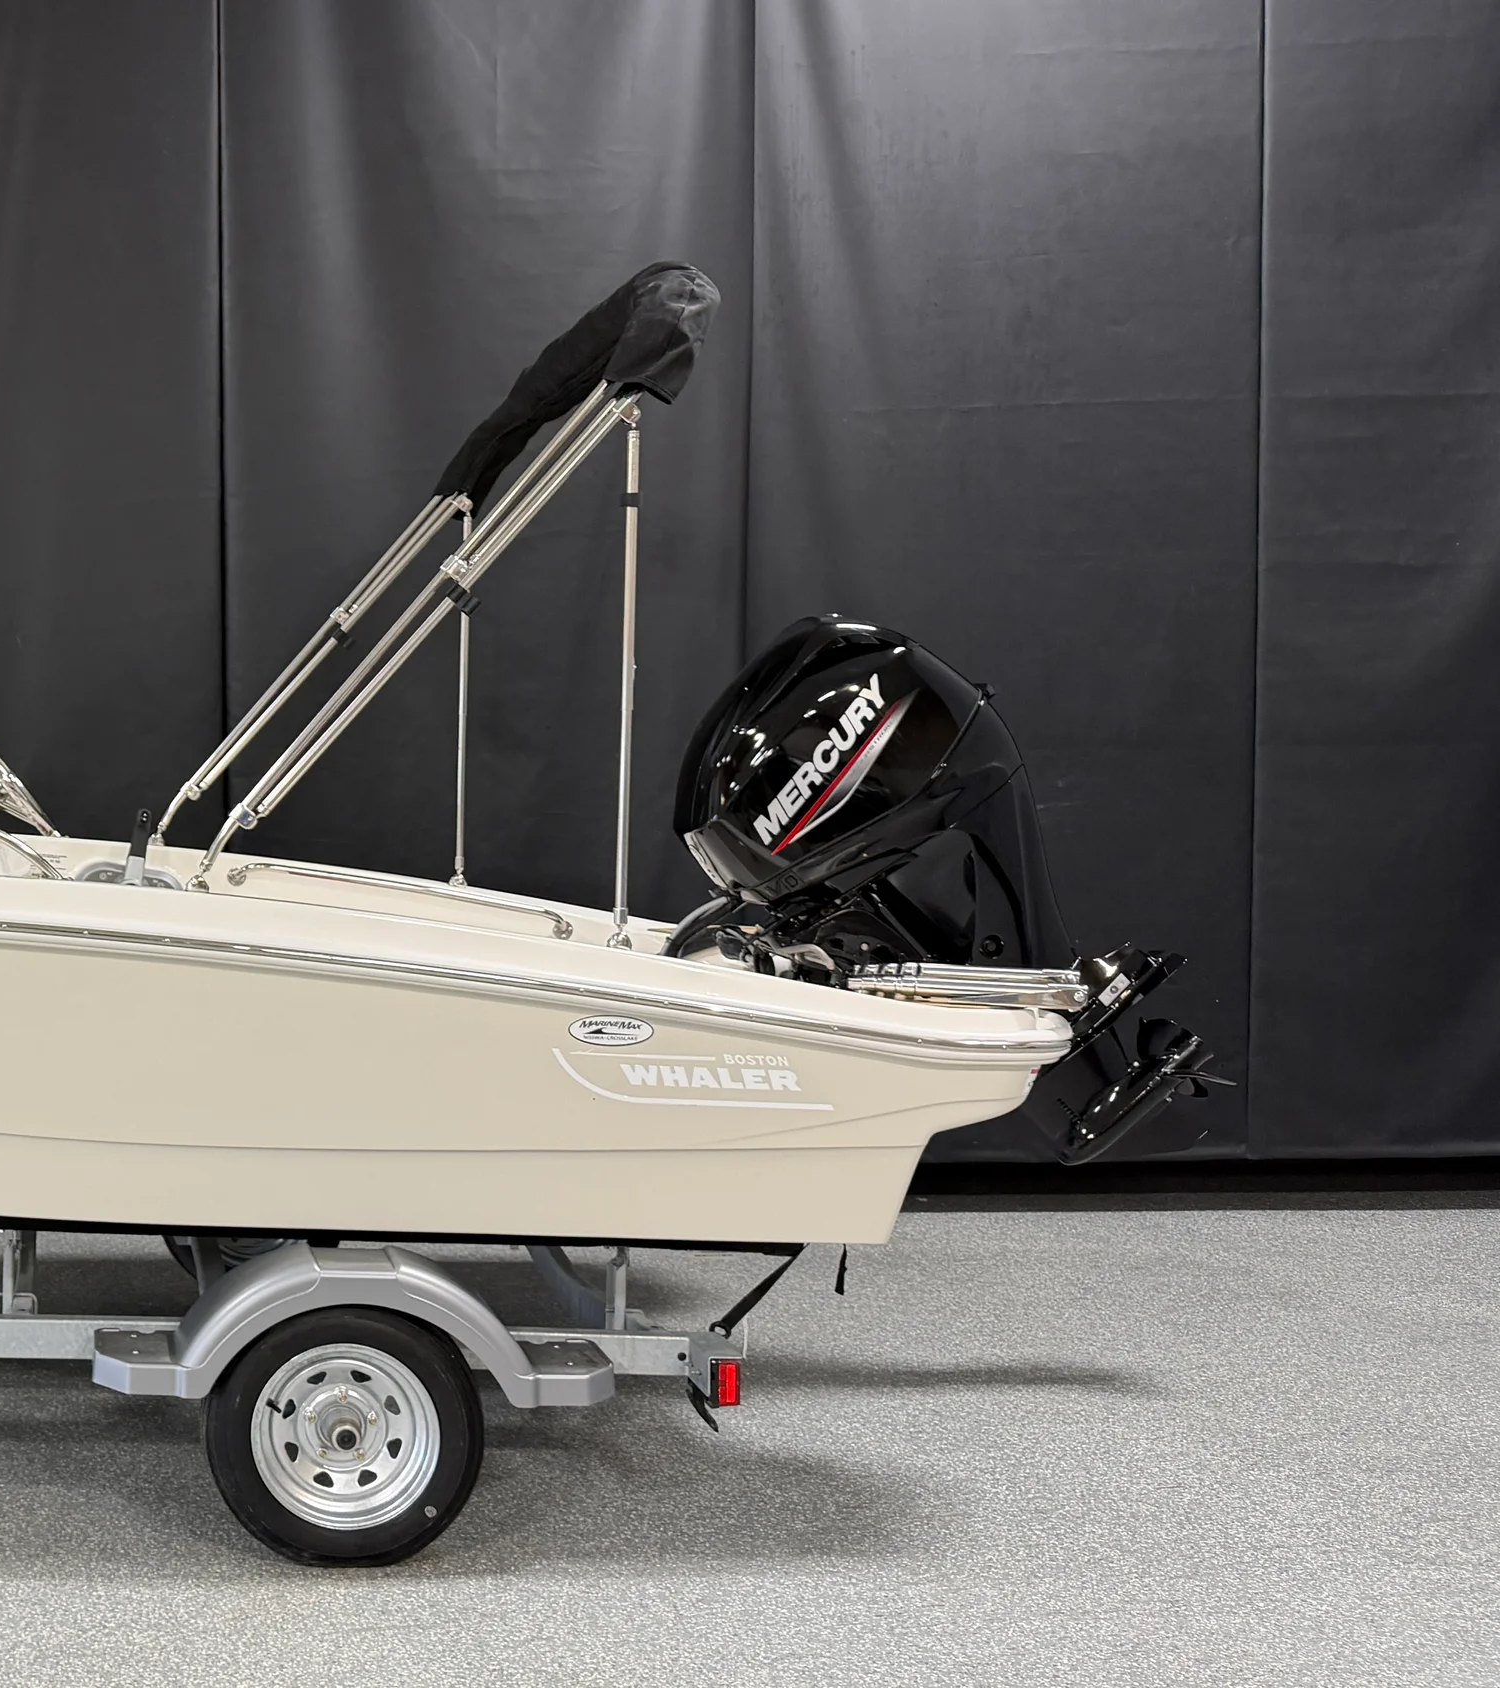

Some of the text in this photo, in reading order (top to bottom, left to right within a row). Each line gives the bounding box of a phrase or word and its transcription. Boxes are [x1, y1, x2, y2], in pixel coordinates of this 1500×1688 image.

[753, 673, 885, 846] MERCURY
[723, 1053, 789, 1067] BOSTON
[619, 1063, 802, 1092] WHALER
